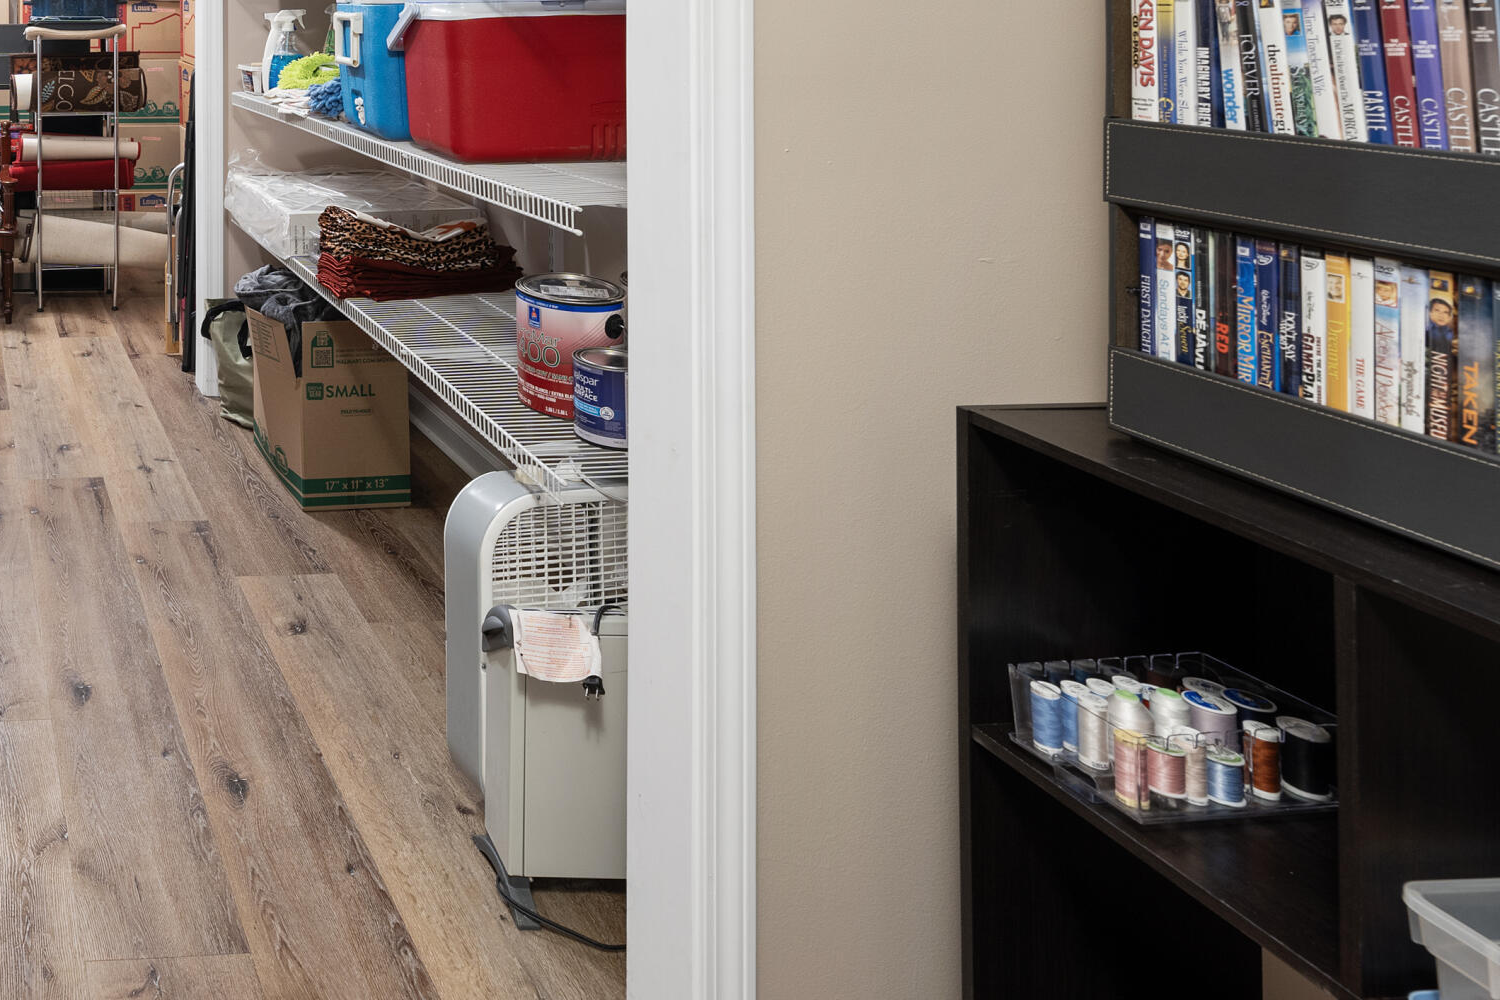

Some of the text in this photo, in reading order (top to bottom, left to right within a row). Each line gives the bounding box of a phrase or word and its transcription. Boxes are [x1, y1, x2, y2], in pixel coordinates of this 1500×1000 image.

[1133, 15, 1140, 28] CD
[1177, 30, 1190, 56] While
[1140, 37, 1155, 88] DAVIS
[1178, 57, 1189, 74] You
[1196, 47, 1211, 99] IMAGINARY
[1239, 34, 1260, 97] FOREVER
[1305, 12, 1326, 97] Time Traveler's Wife
[1179, 75, 1189, 98] Were
[1221, 68, 1241, 124] wonder
[1267, 44, 1291, 135] theultimategi
[1363, 90, 1387, 132] CASTLE
[1393, 95, 1414, 148] CASTLE
[1421, 97, 1442, 150] CASTLE
[1446, 87, 1472, 153] CASTLE
[1476, 88, 1500, 155] CASTLE
[1141, 273, 1153, 355] FIRST DAUGHT
[1157, 279, 1170, 330] Sundays
[1176, 304, 1193, 354] lucky Seven
[518, 338, 561, 368] 400
[1159, 333, 1171, 347] At
[1216, 321, 1229, 355] RED
[1237, 295, 1256, 384] MIRROR MIR
[1284, 311, 1298, 363] DON'T SAY
[1328, 320, 1345, 380] Dreamer
[1376, 323, 1396, 356] Alice
[326, 384, 376, 398] SMALL
[574, 370, 600, 387] alspar
[1356, 358, 1366, 409] THE GAME
[1431, 351, 1449, 389] NIGHT
[1462, 361, 1479, 445] TAKEN
[325, 480, 340, 491] 17"
[351, 480, 363, 490] 11"
[375, 478, 389, 489] 13"
